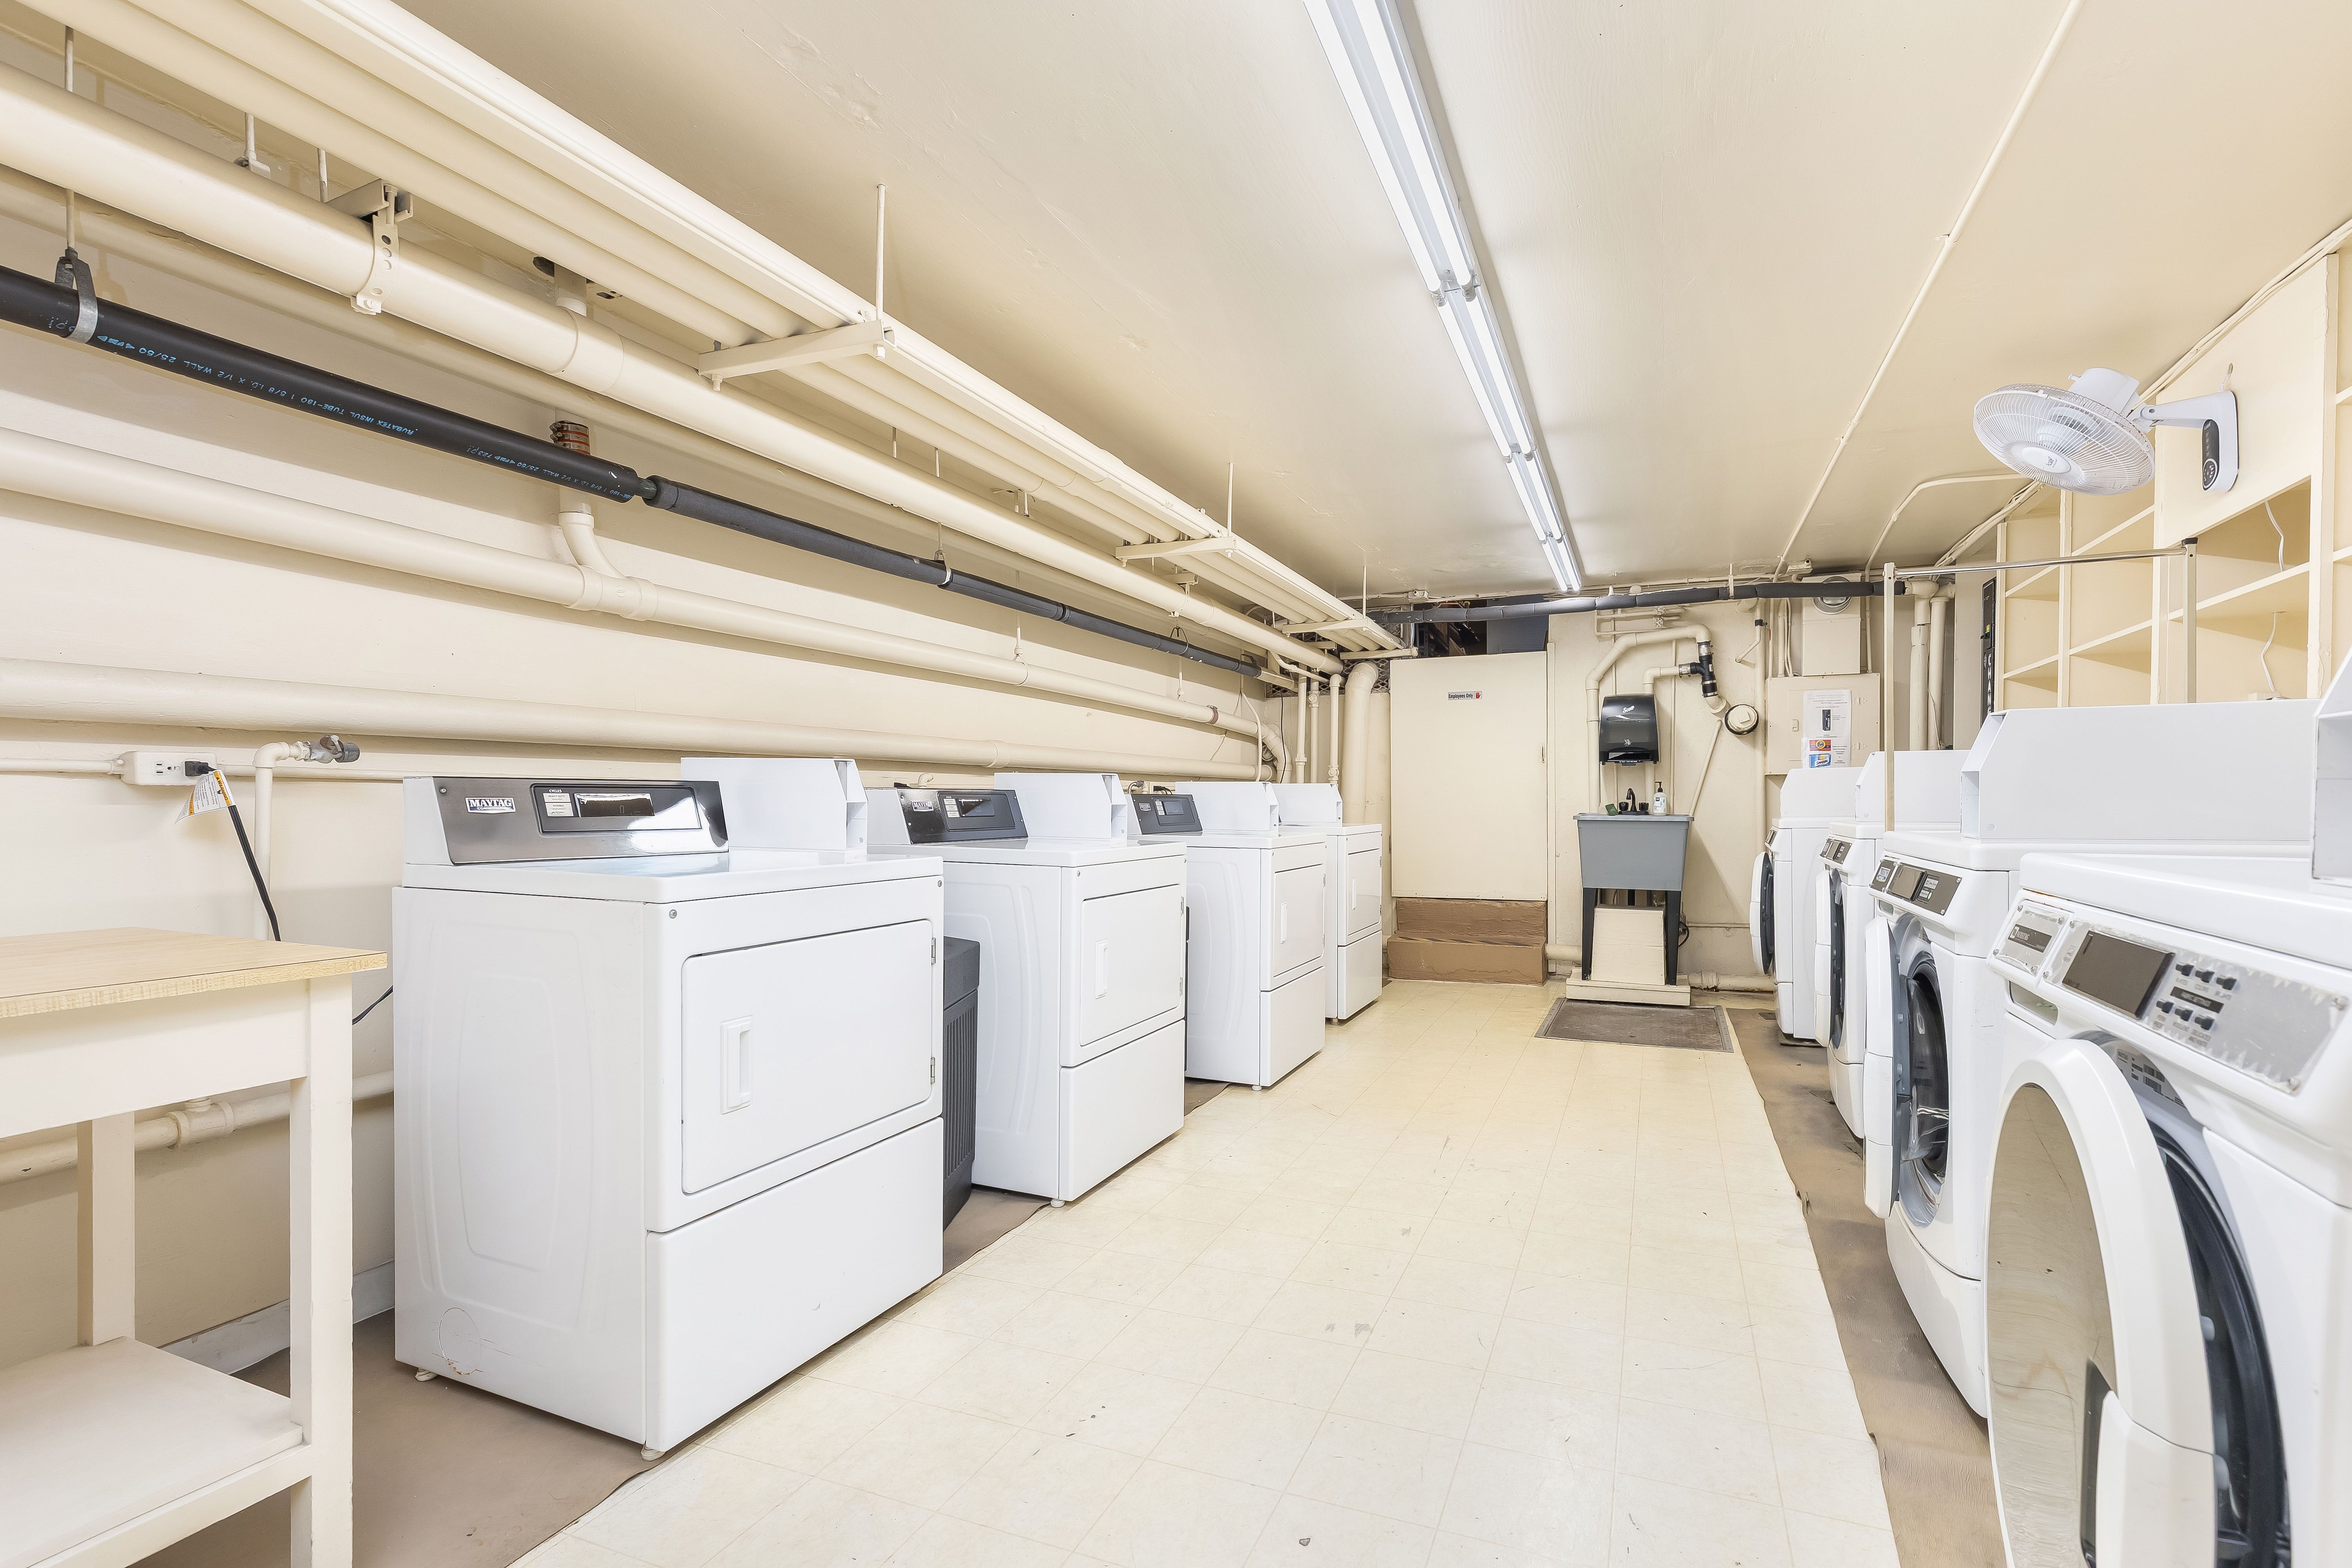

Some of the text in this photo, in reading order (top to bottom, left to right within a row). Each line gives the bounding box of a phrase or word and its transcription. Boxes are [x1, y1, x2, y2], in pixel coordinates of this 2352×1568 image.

[183, 360, 212, 373] WALL
[218, 371, 233, 381] 1/2
[268, 387, 287, 397] 5/8
[300, 396, 345, 414] TUBE-180
[350, 411, 374, 423] INSUL
[376, 420, 415, 435] RUBATEX
[543, 469, 560, 477] WALL
[218, 780, 229, 801] WARNING
[468, 799, 512, 807] MAYTAG
